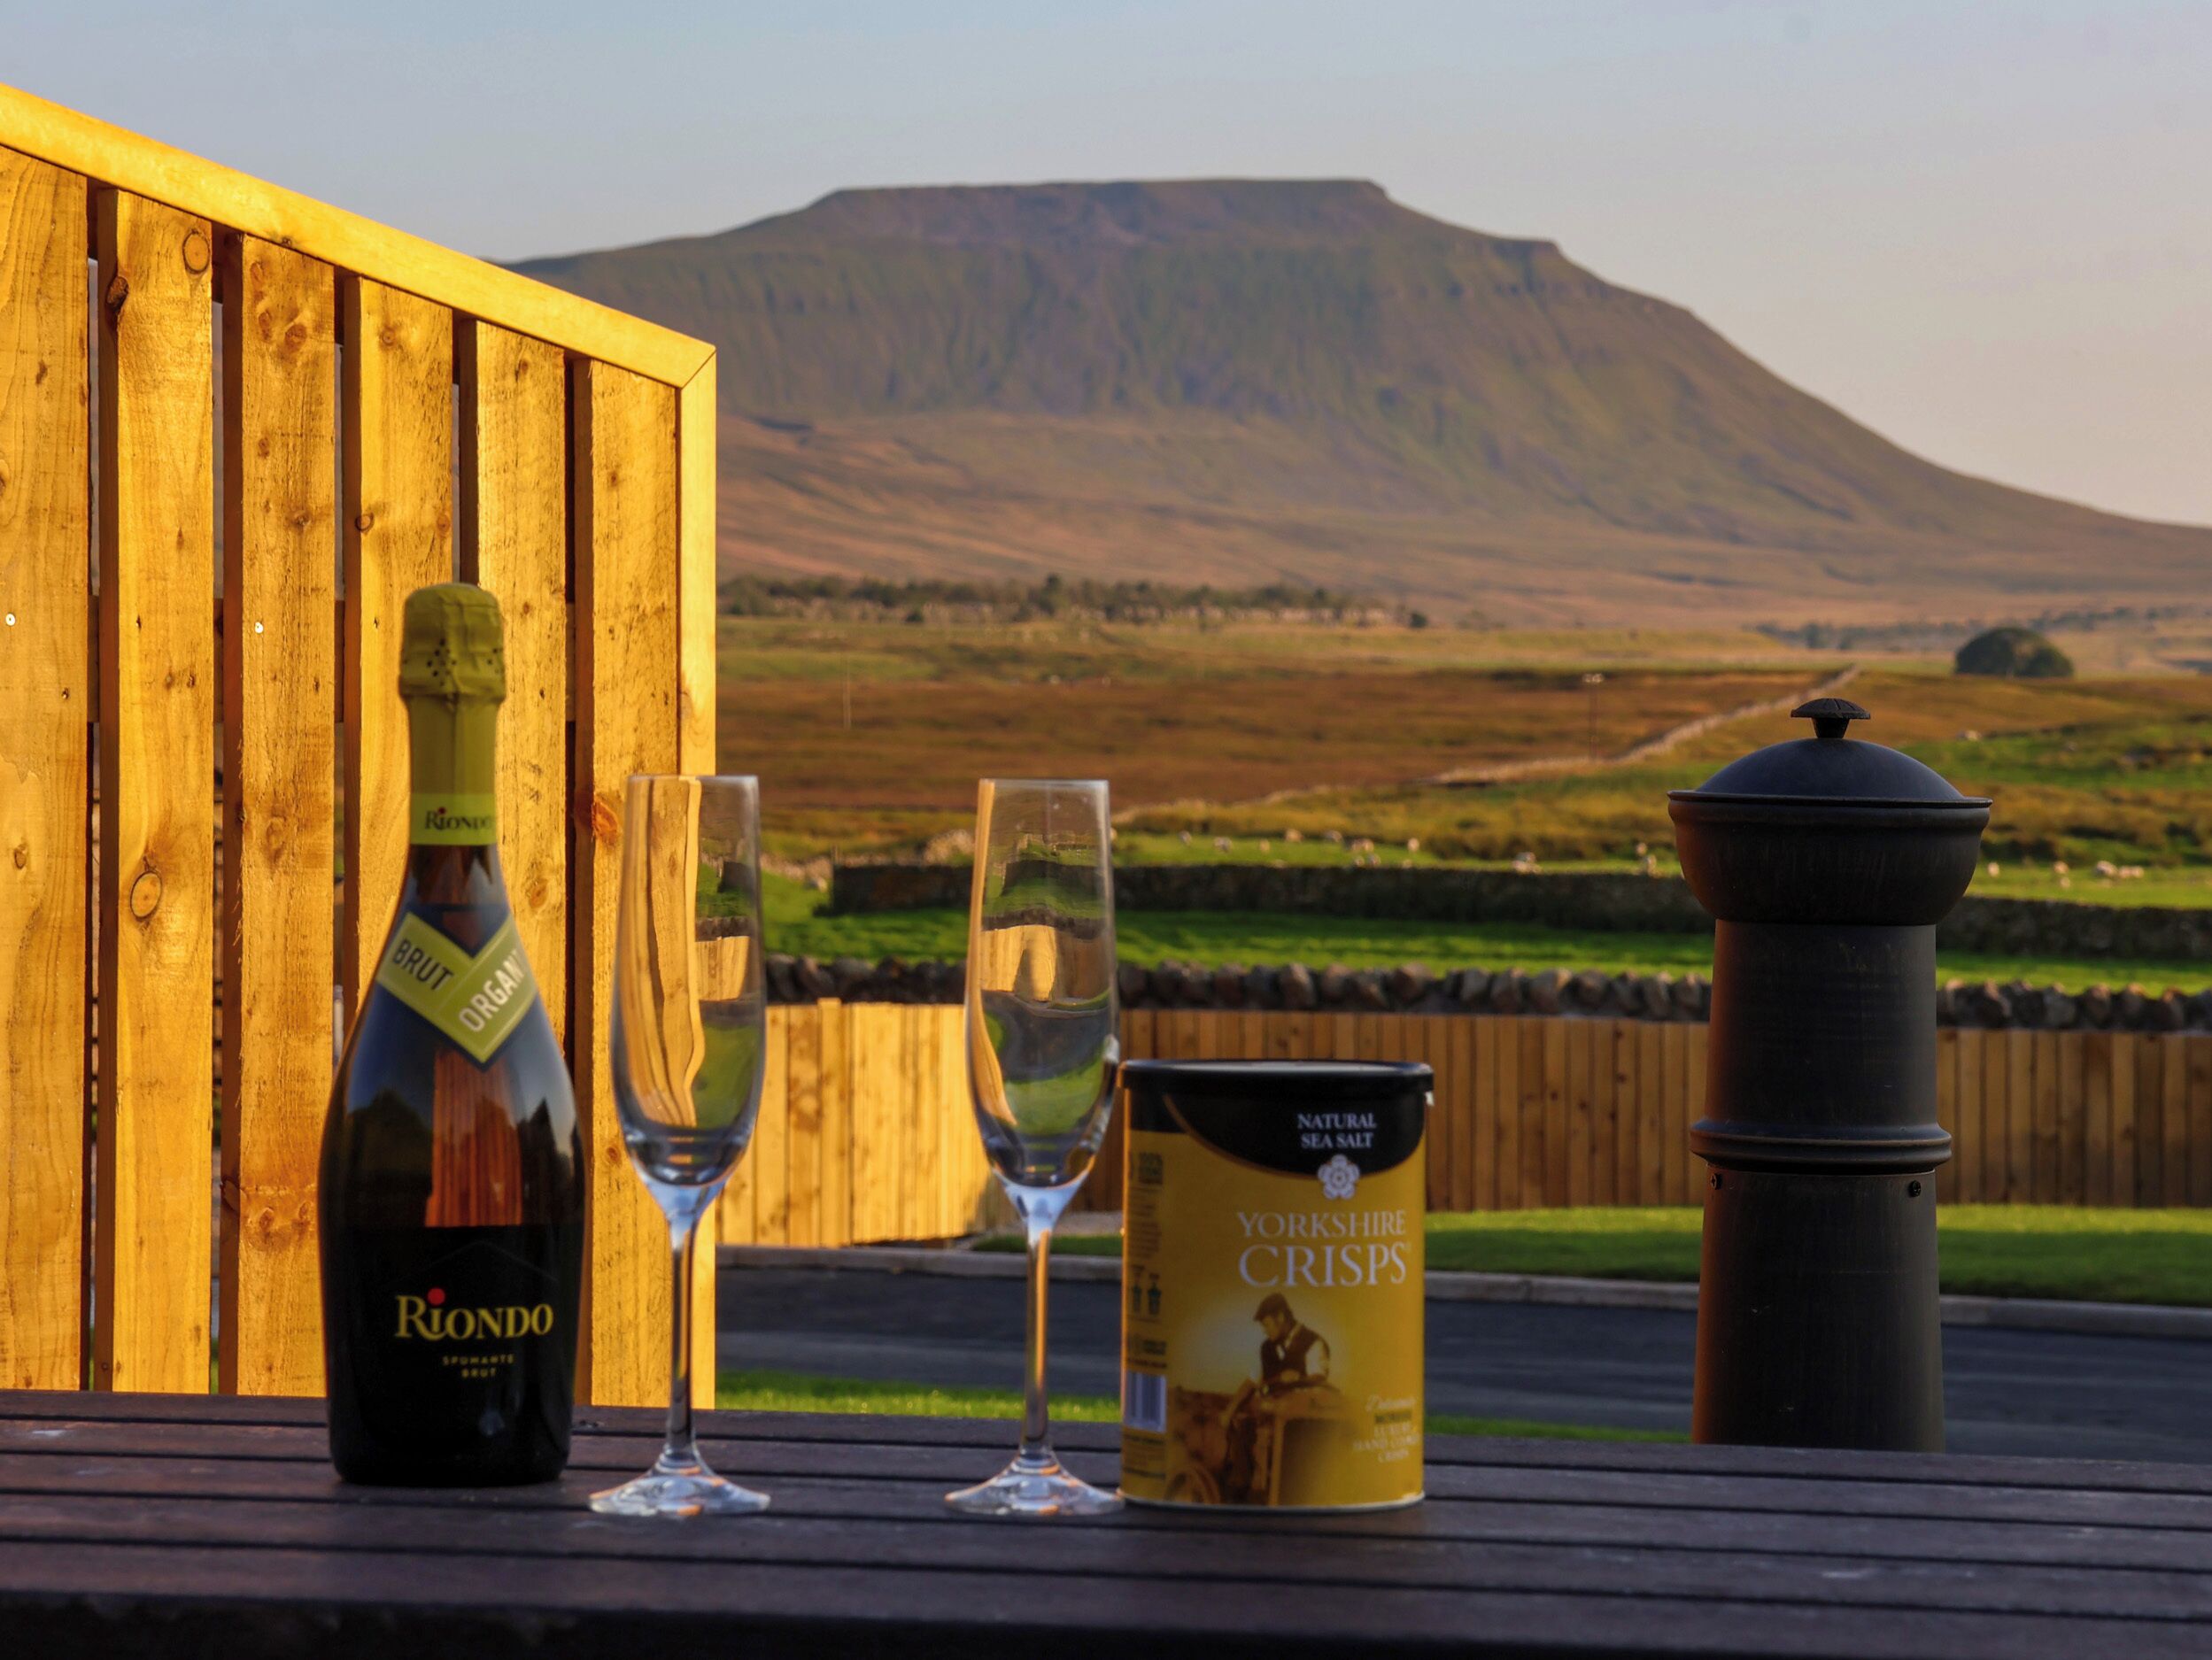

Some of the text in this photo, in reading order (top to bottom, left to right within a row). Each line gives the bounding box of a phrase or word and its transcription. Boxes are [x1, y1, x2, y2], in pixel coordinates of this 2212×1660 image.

[392, 939, 453, 992] BRUT
[1297, 1113, 1376, 1130] NATURAL
[1301, 1133, 1373, 1149] SEA SALT
[1237, 1210, 1406, 1239] YORKSHIRE
[1239, 1243, 1407, 1288] CRISPS
